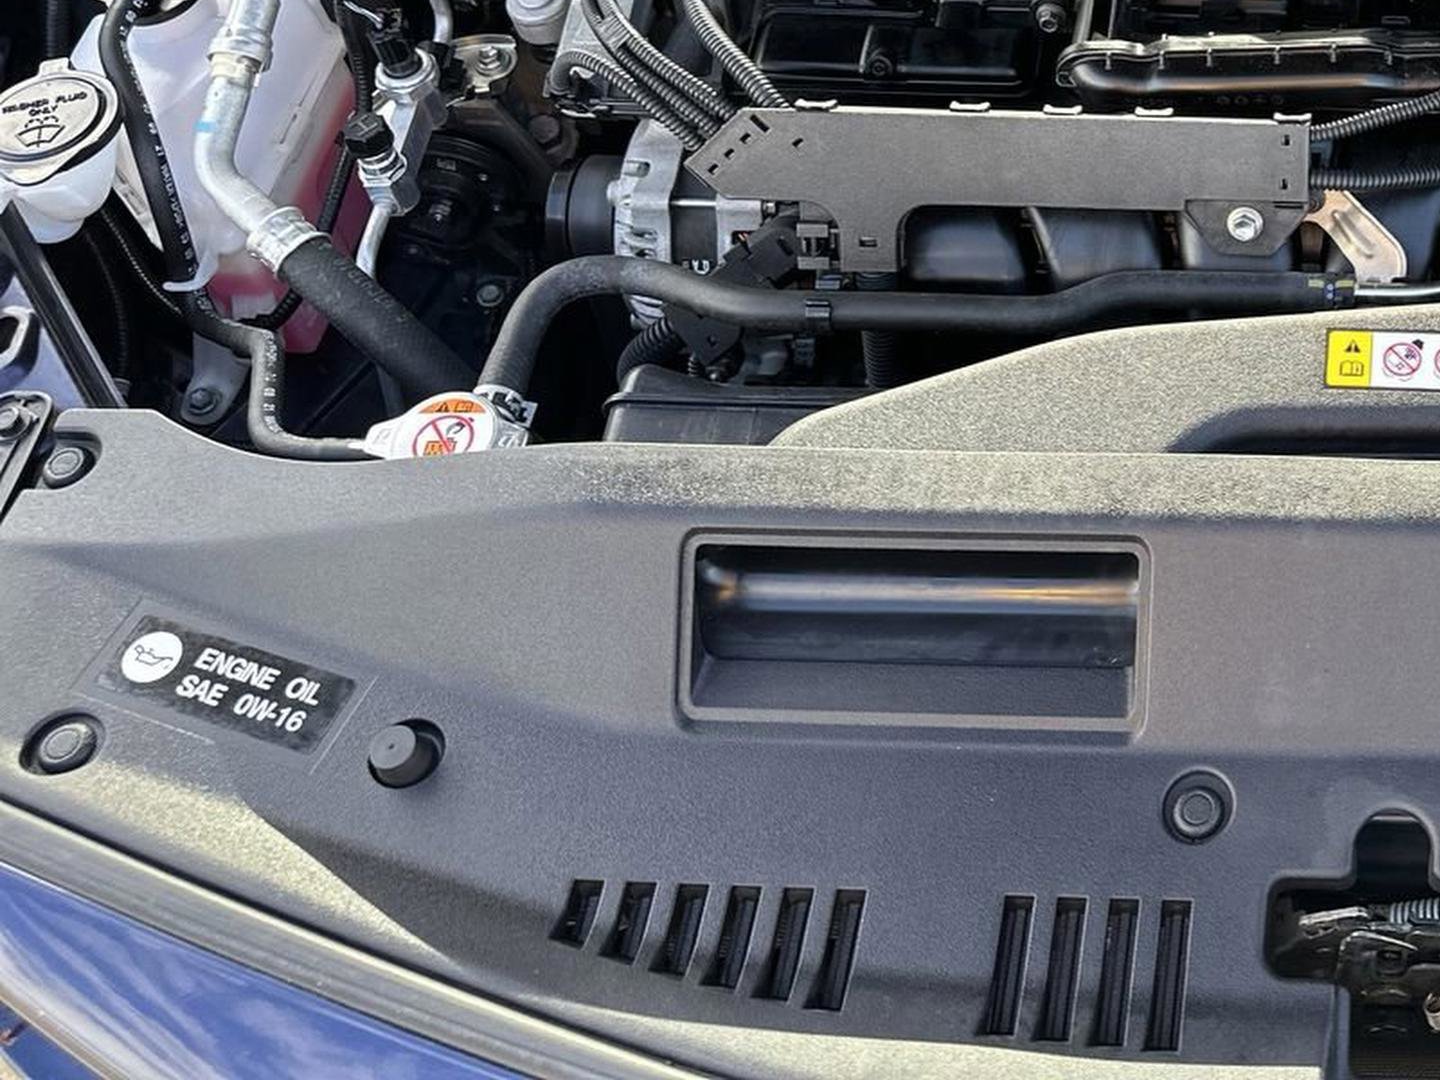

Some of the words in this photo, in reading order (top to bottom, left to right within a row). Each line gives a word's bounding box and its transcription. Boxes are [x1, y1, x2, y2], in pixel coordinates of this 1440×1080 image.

[175, 674, 229, 706] SAE
[233, 693, 307, 732] 0W-16
[194, 647, 281, 690] ENGINE
[285, 677, 321, 706] OIL
